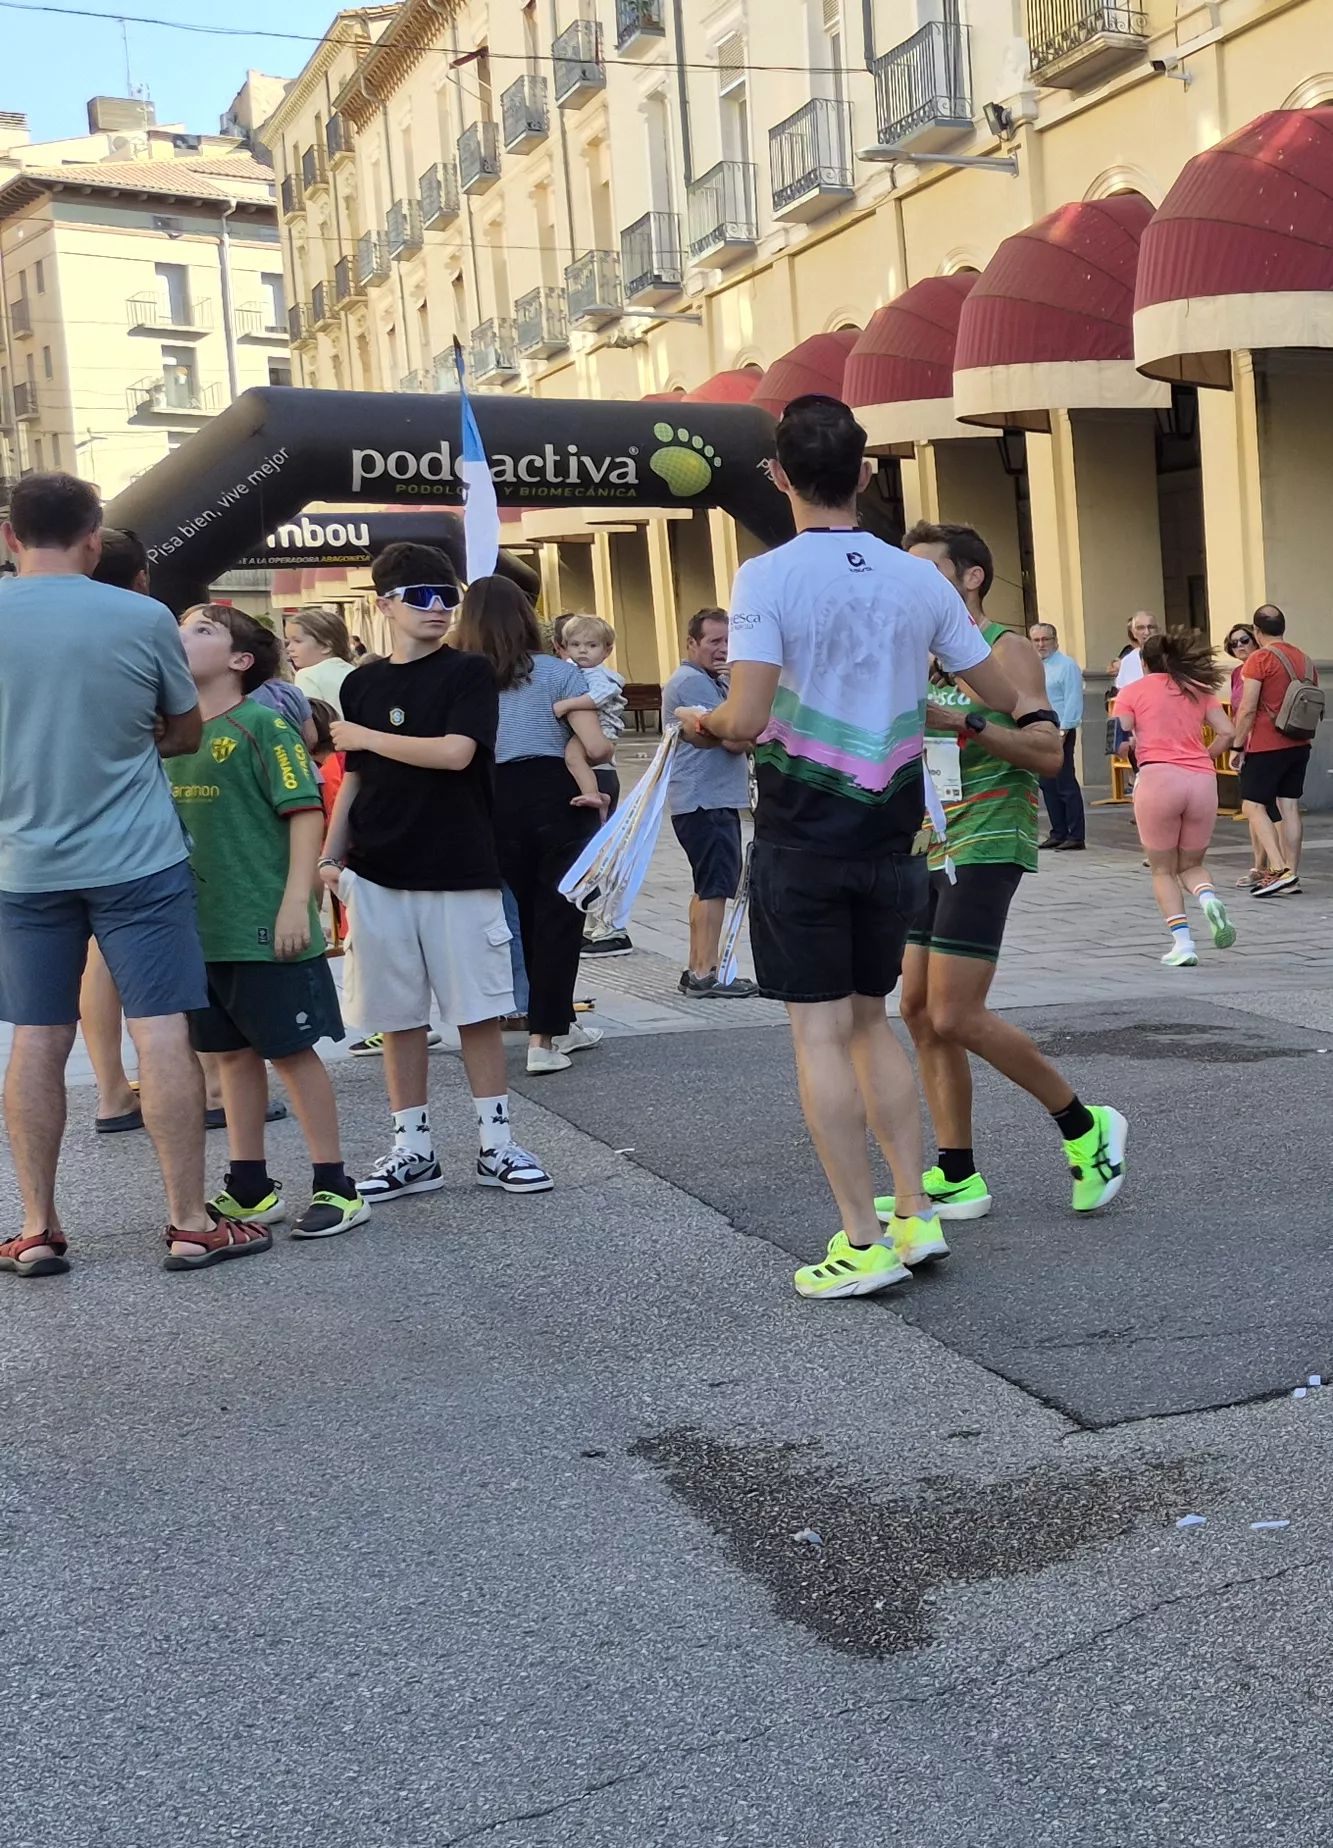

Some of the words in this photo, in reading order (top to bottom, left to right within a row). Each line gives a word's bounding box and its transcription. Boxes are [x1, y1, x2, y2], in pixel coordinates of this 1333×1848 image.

[147, 535, 184, 565] Pisa
[177, 509, 223, 539] bien,
[217, 483, 250, 508] vive
[247, 446, 289, 486] mejor
[505, 486, 512, 497] Y
[520, 482, 638, 498] BIOMECÁNICA
[266, 517, 370, 548] mbou
